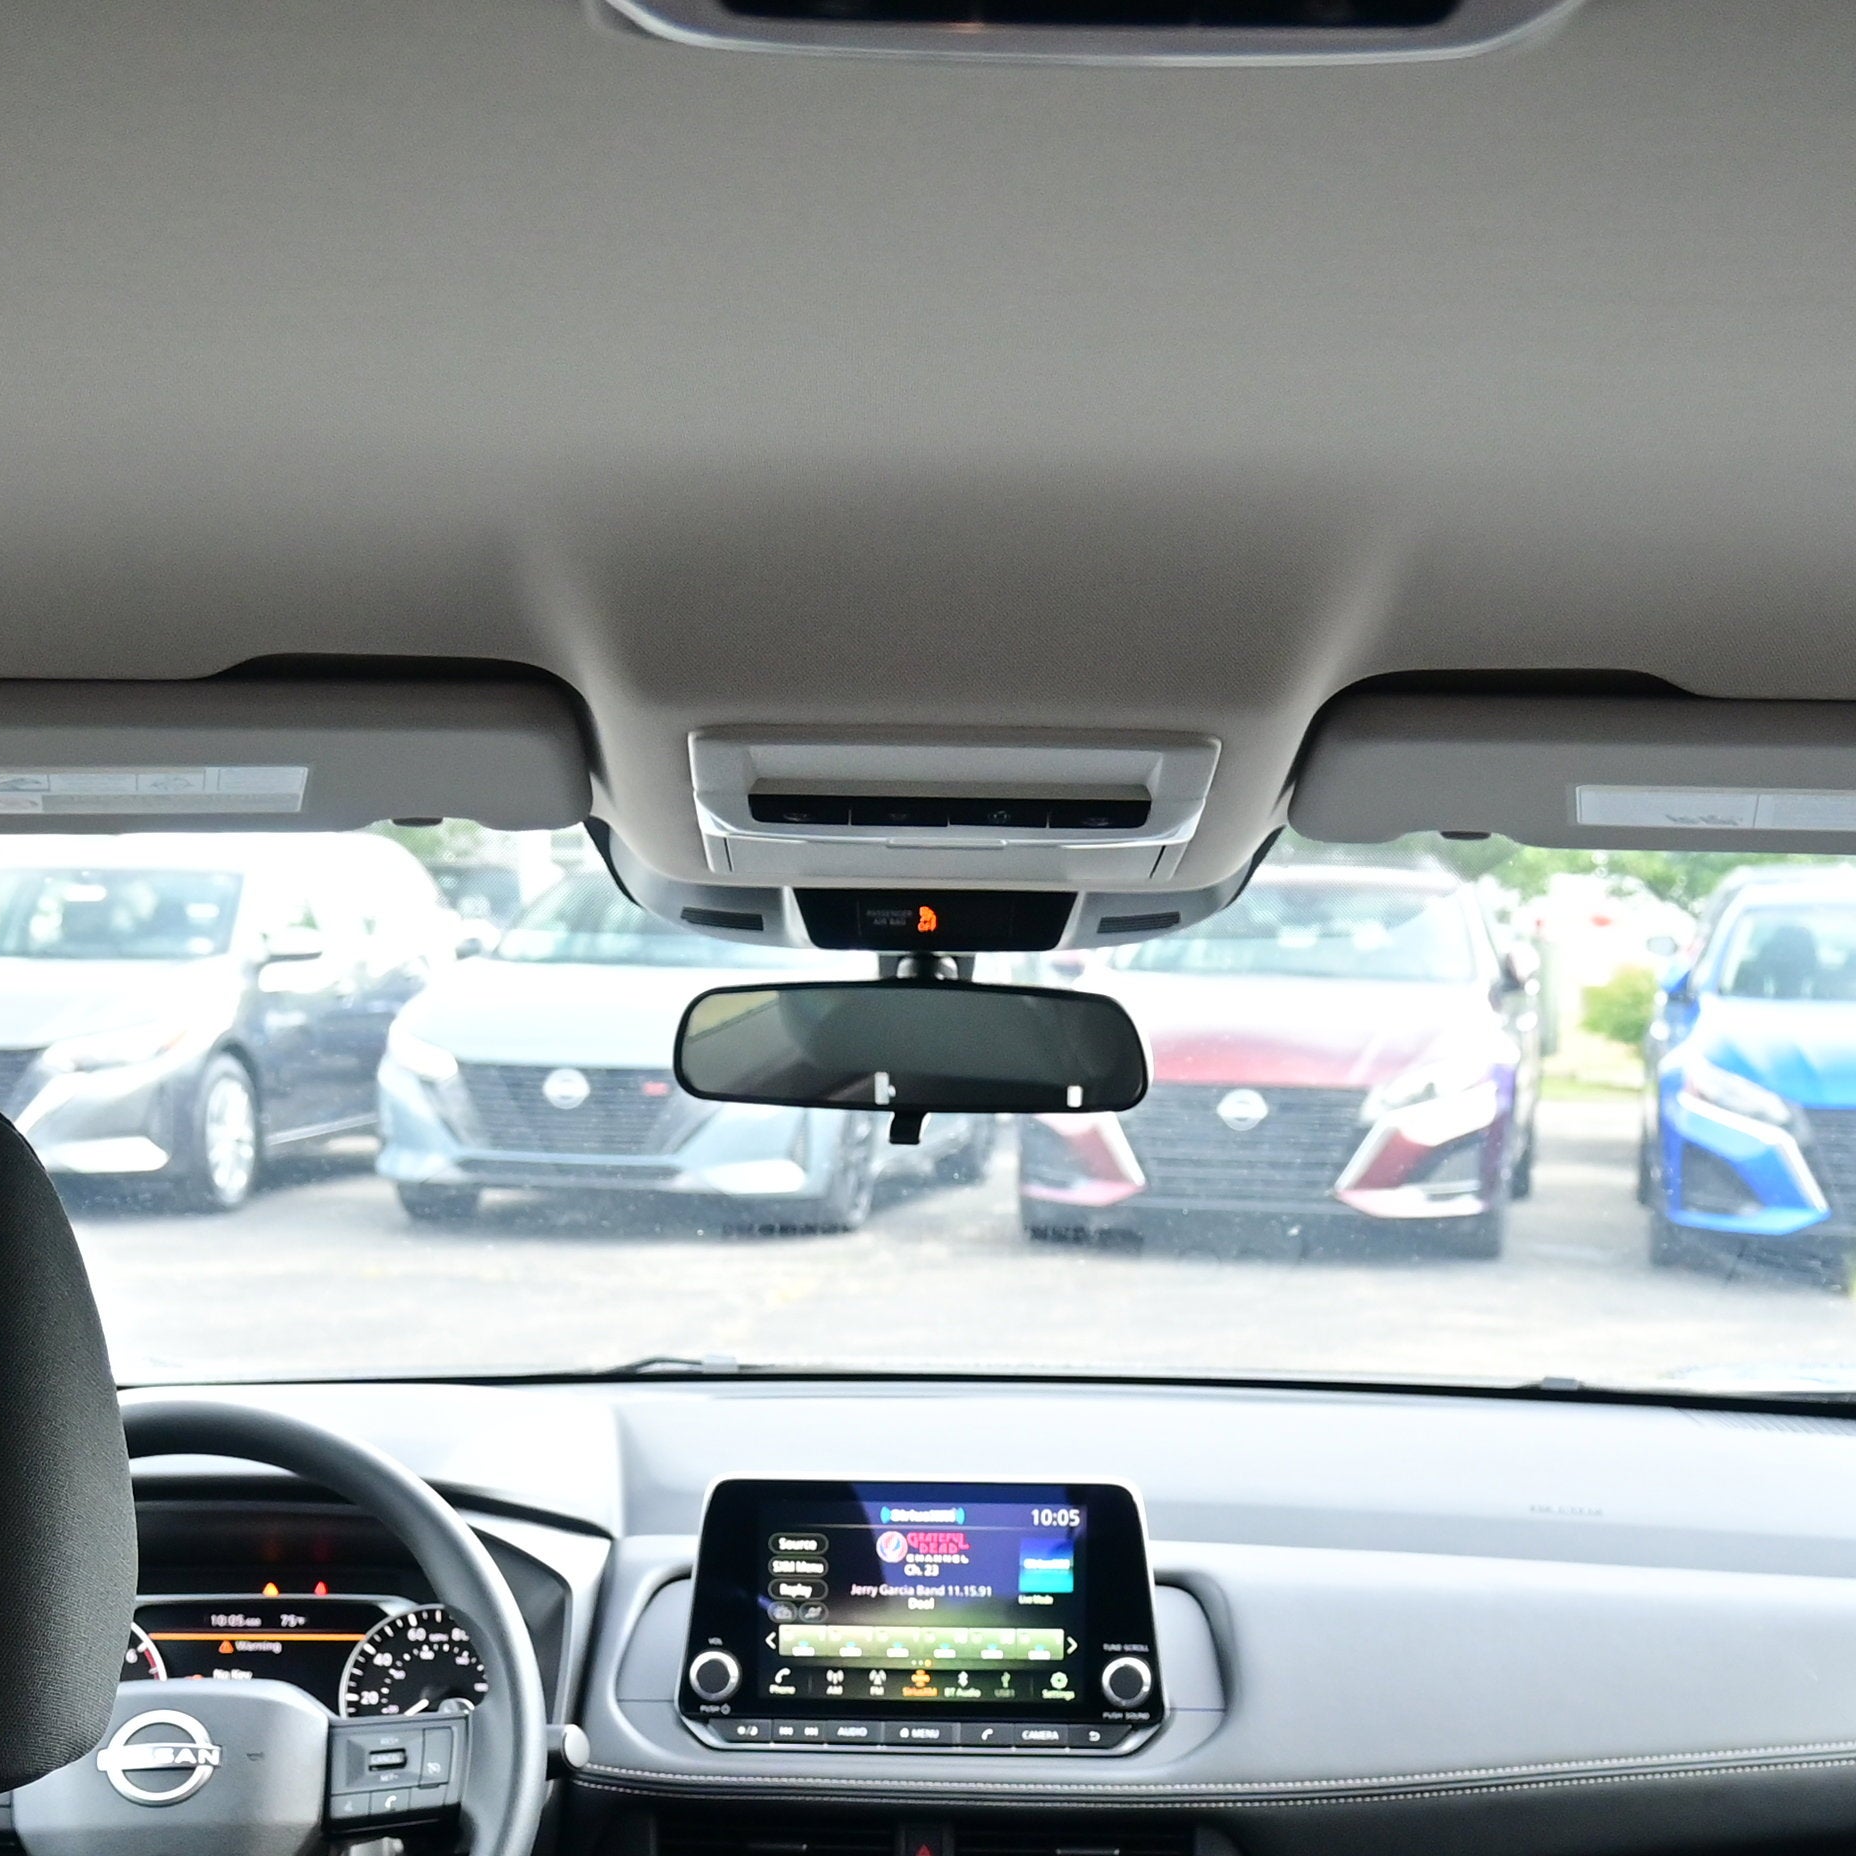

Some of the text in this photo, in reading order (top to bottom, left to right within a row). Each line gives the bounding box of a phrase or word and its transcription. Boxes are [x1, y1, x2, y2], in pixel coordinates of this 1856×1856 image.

[1031, 1508, 1081, 1527] 10:05
[850, 1584, 878, 1599] Jerry
[879, 1584, 915, 1597] Garcia
[916, 1584, 945, 1597] Band
[407, 1627, 427, 1642] 60
[373, 1652, 393, 1667] 40
[360, 1690, 379, 1705] 20
